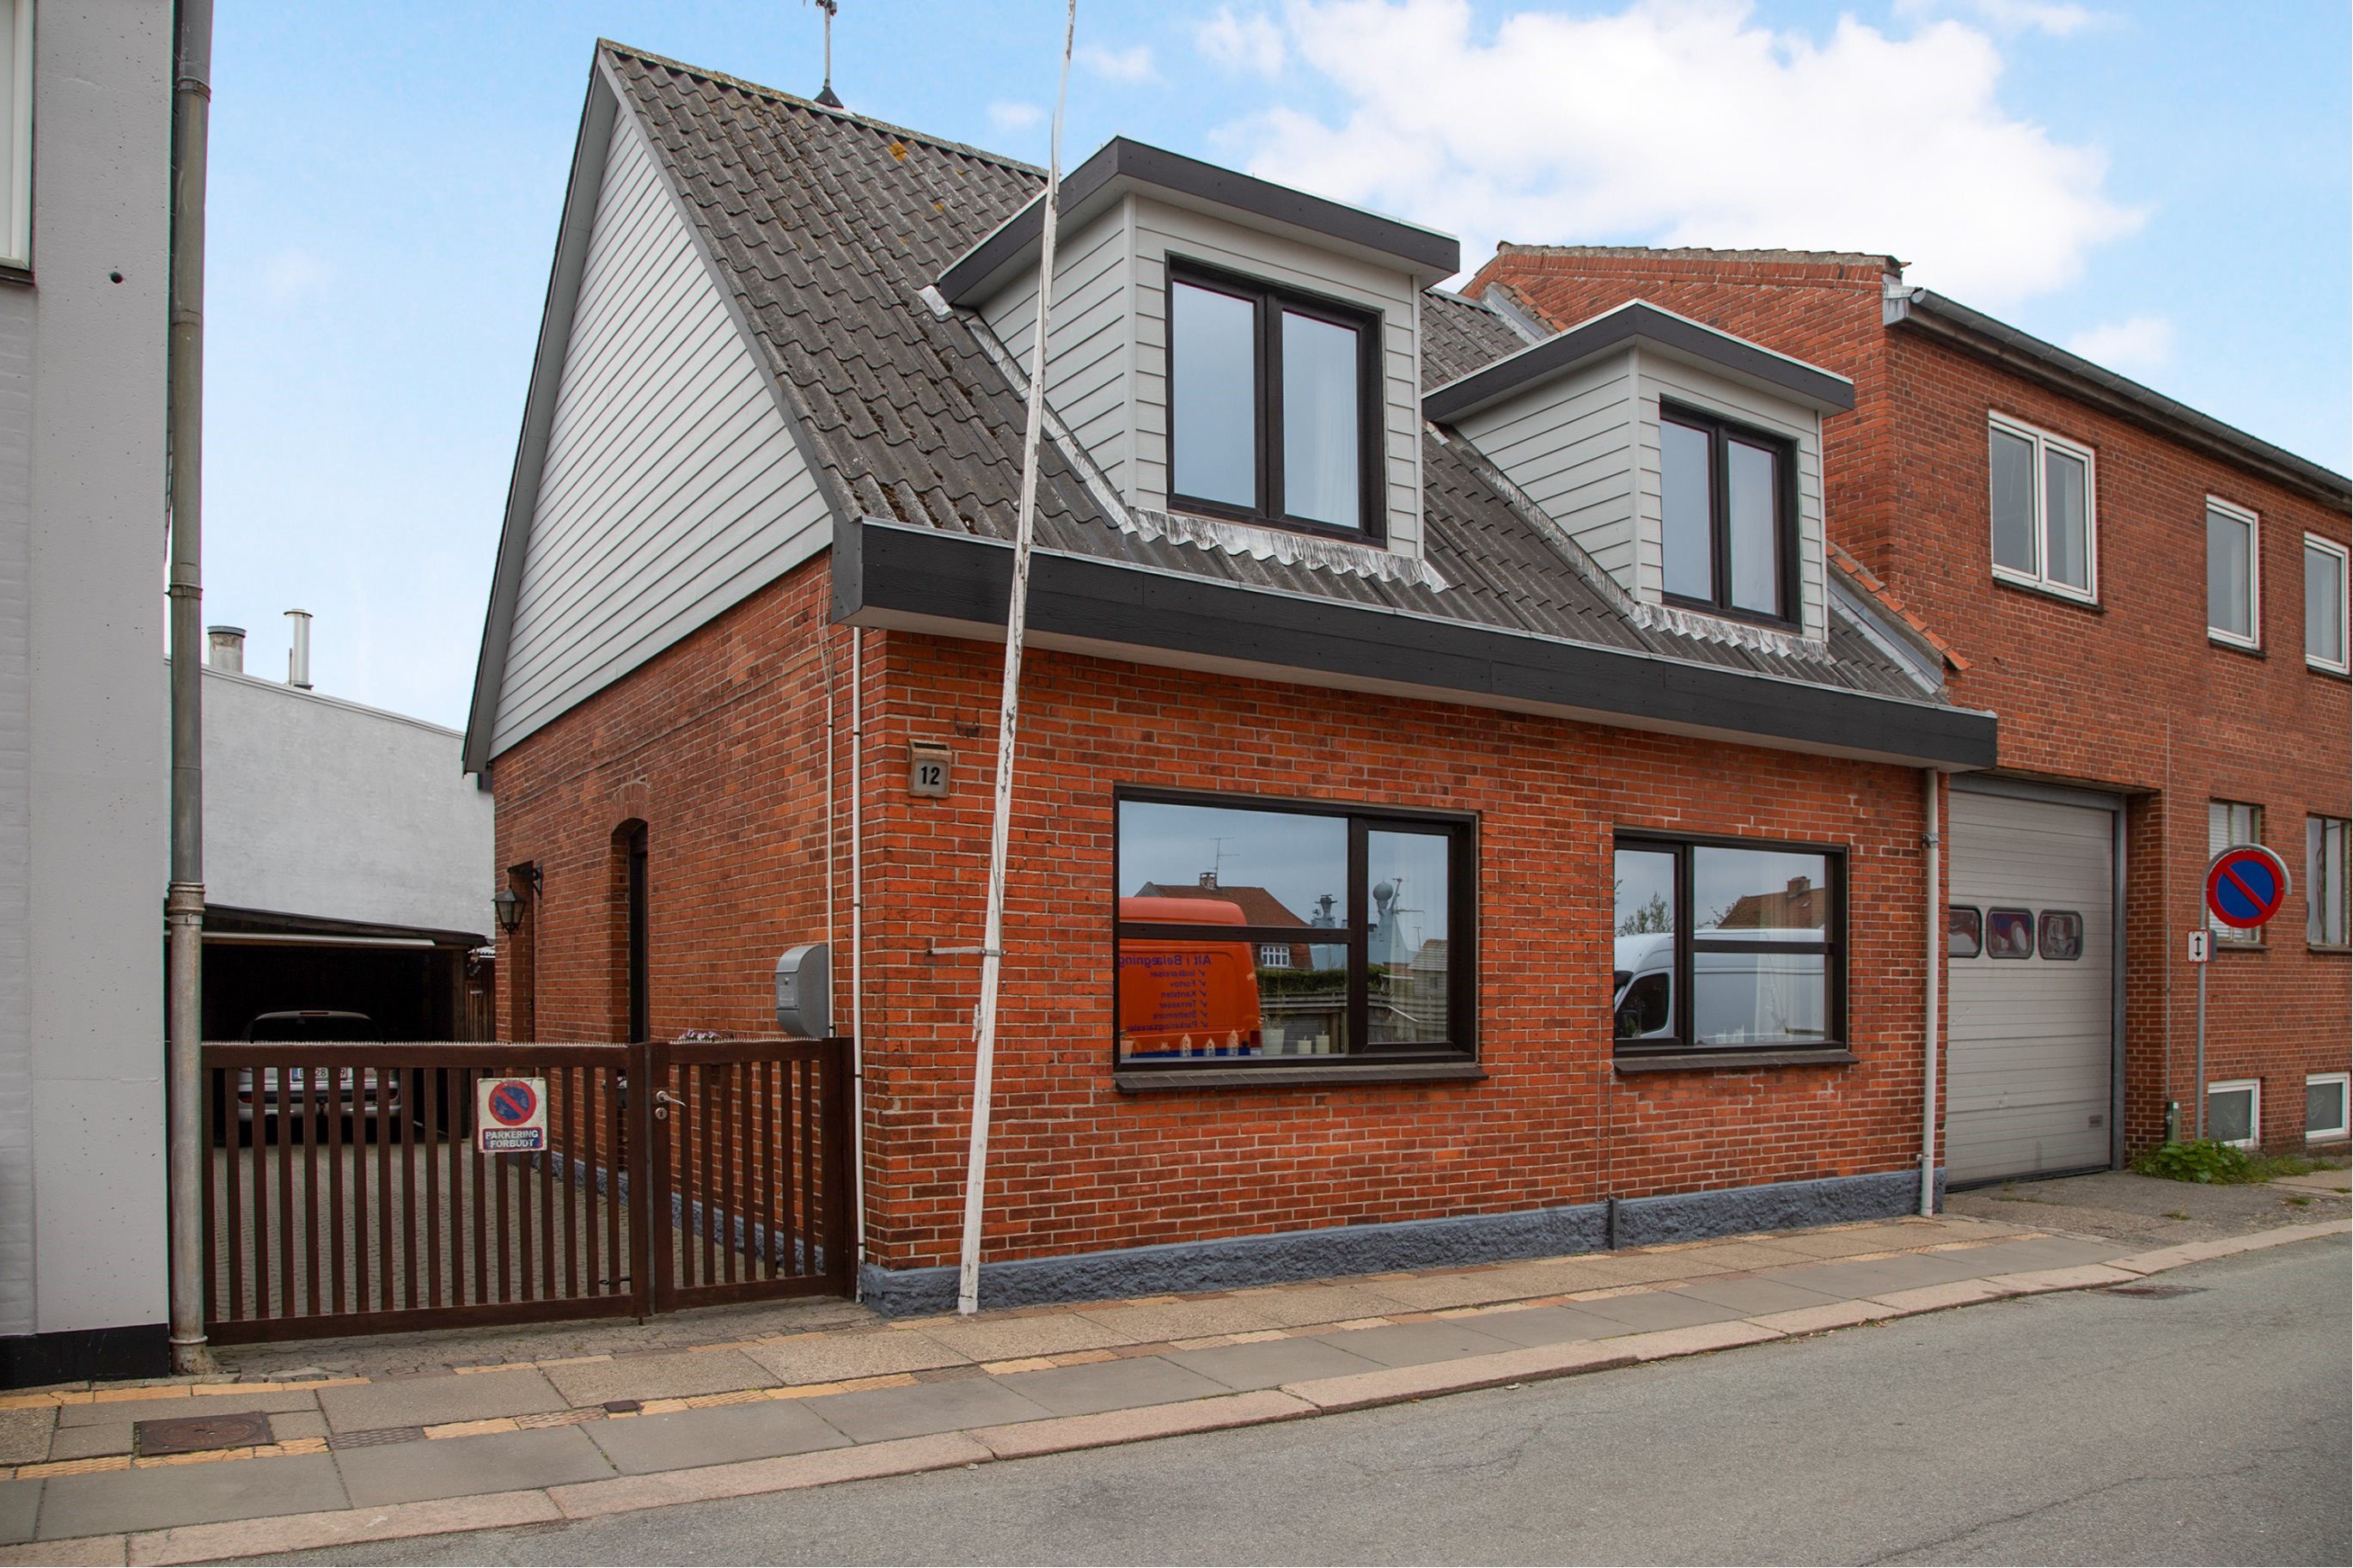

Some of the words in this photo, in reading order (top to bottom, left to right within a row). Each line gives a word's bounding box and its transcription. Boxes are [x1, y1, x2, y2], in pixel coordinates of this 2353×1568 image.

[920, 766, 940, 785] 12
[485, 1130, 539, 1139] PARKERING
[490, 1138, 535, 1148] FORBUDT
